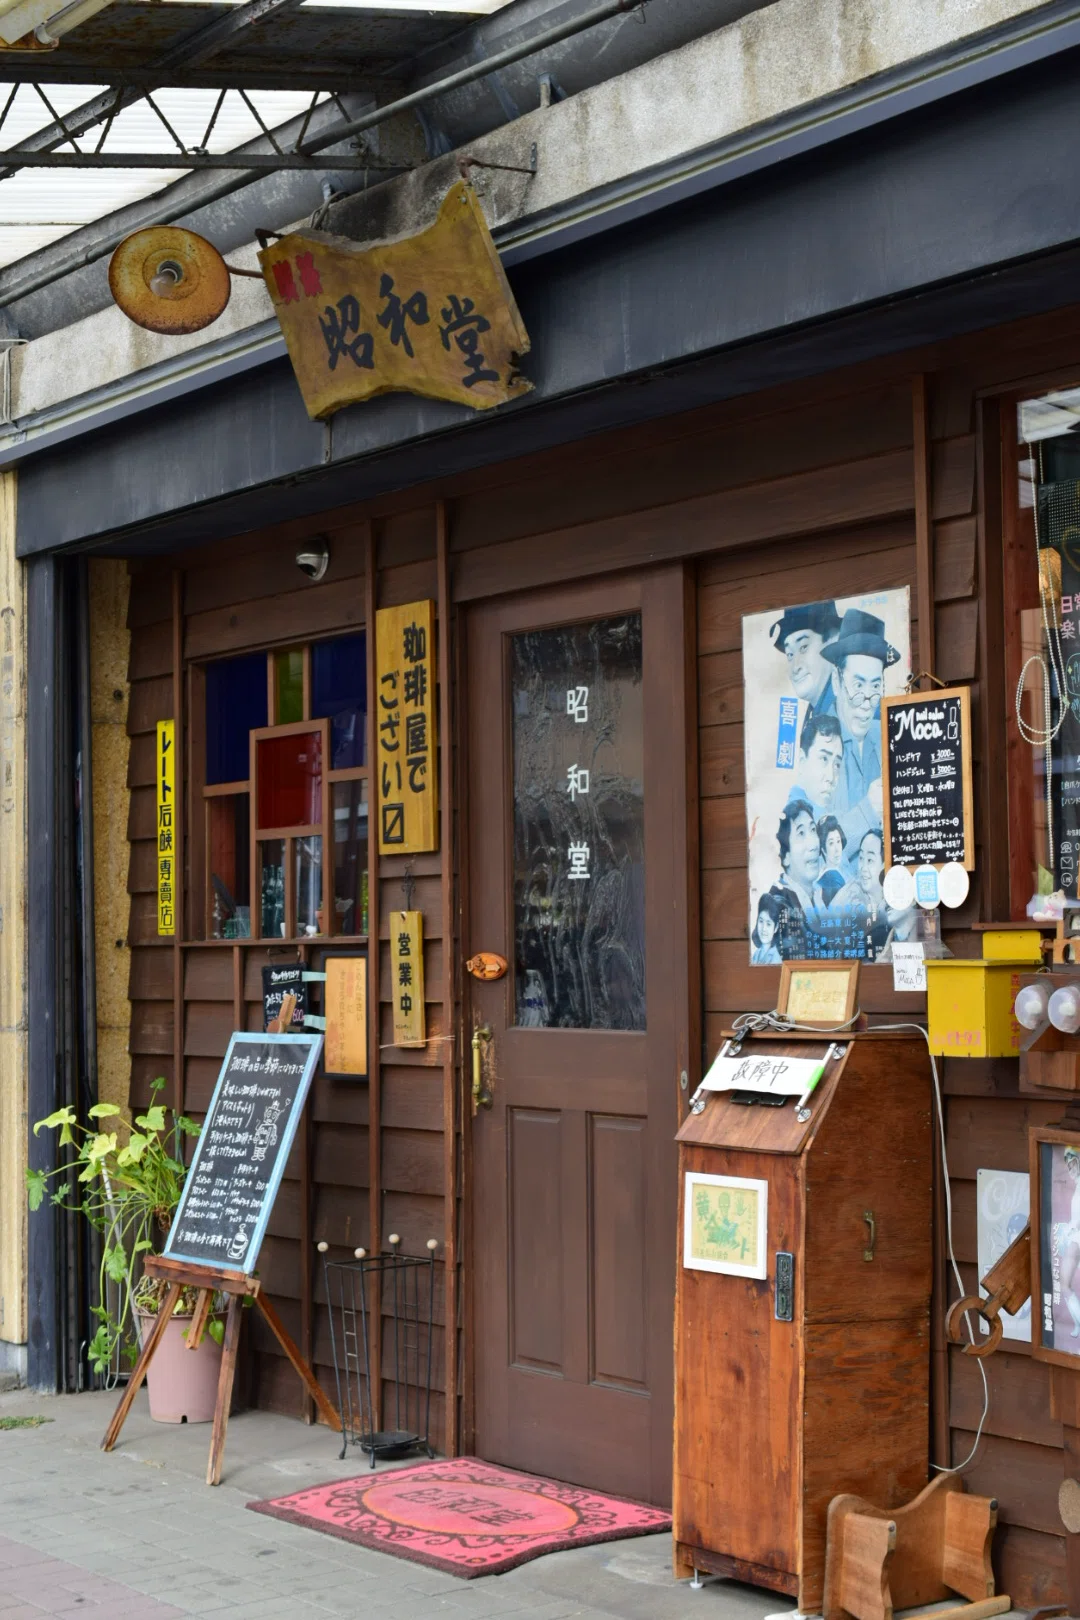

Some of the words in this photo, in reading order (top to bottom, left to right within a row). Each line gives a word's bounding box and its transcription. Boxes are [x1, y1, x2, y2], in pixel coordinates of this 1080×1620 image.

[319, 274, 500, 388] 昭和堂
[403, 622, 428, 794] 珈琲屋で
[778, 701, 797, 766] 喜劇
[894, 708, 943, 741] Moca
[566, 686, 590, 879] 昭和堂
[398, 932, 412, 1016] 営業中
[731, 1060, 789, 1086] 故障中
[394, 1487, 536, 1526] 昭和堂
